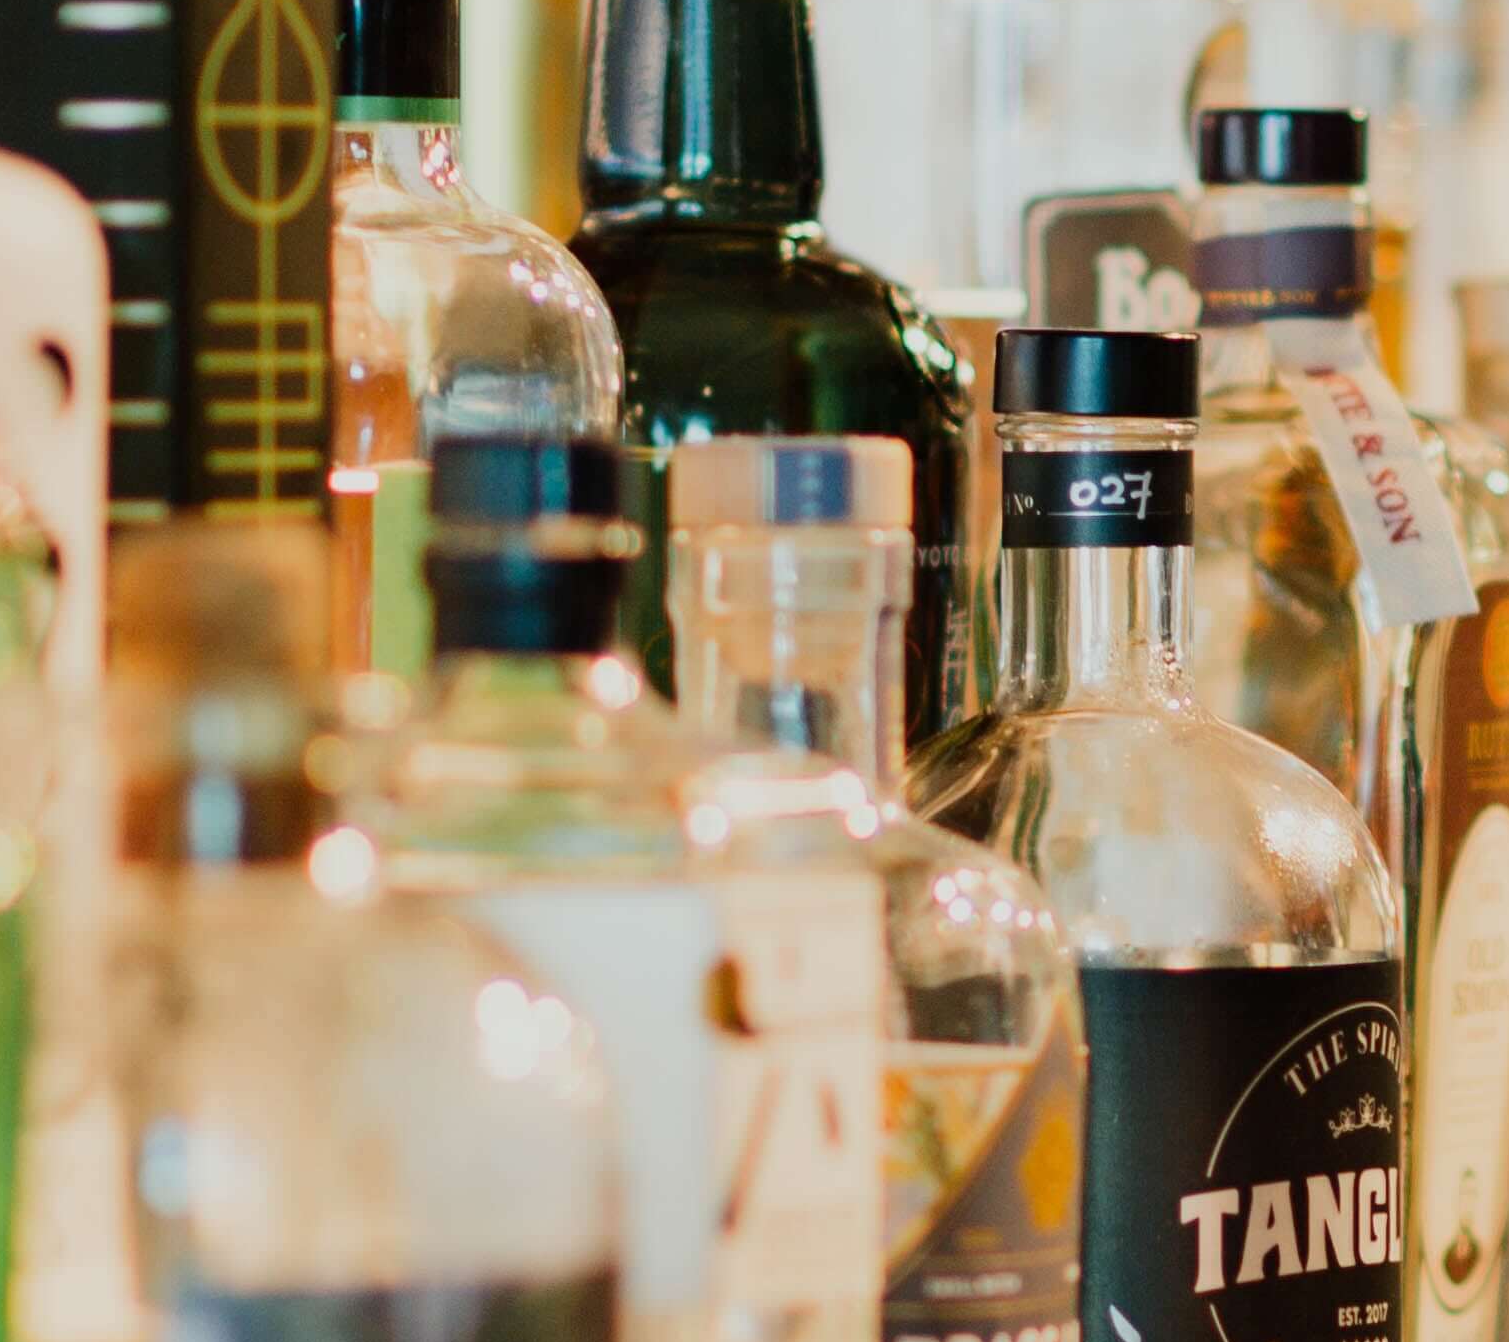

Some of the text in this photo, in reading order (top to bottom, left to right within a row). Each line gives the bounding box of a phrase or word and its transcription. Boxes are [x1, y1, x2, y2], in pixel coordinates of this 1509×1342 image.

[1070, 471, 1153, 520] 027
[1366, 466, 1422, 545] SON
[1283, 1030, 1348, 1097] THE
[1337, 1301, 1389, 1328] EST. 2017
